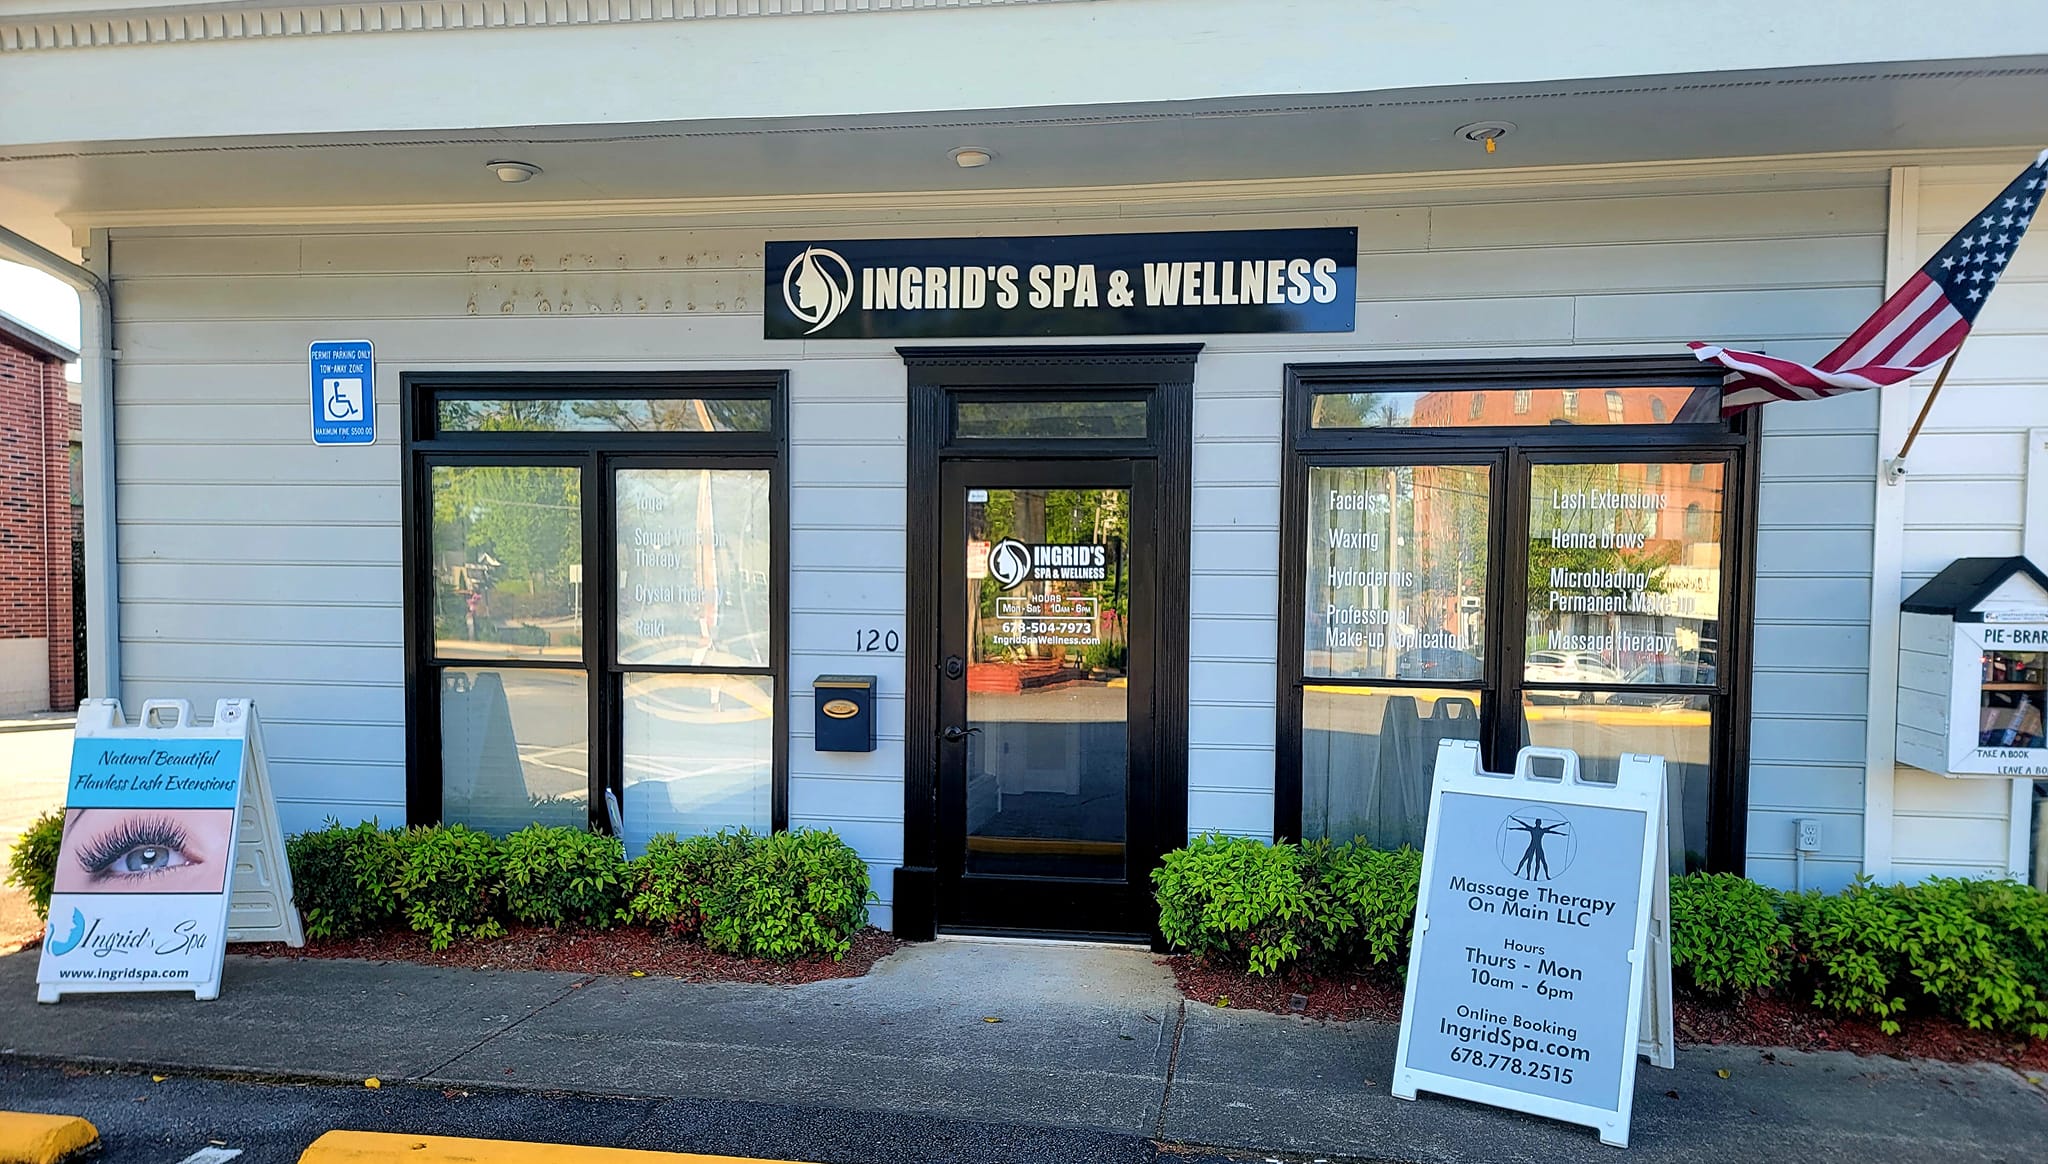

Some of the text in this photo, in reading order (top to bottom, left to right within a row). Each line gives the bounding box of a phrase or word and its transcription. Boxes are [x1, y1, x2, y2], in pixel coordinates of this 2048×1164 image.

[862, 258, 1337, 310] INGRID'S SPA & WELLNESS
[311, 351, 371, 360] PERMIT PARKING ONLY
[349, 364, 364, 373] ZONE
[315, 427, 373, 435] MAXIMUM FINE $500.00
[1330, 490, 1376, 510] Facials
[1553, 489, 1667, 509] Lash Extensions
[635, 528, 670, 546] Sound
[1329, 528, 1379, 551] Waxing
[1552, 528, 1645, 549] Henna brows
[635, 549, 681, 568] Therapy
[1034, 546, 1105, 566] INGRID'S
[1034, 567, 1105, 579] SPA & WELLNESS
[1551, 567, 1653, 591] Microblading/
[635, 584, 674, 605] Crystal
[1031, 595, 1062, 603] HOURS
[1550, 591, 1695, 615] Permanent Make-up
[635, 619, 664, 637] Reiki
[1002, 623, 1091, 633] 678-504-7973
[857, 629, 899, 652] 120
[993, 636, 1100, 645] IngridSpaWellness.com
[1326, 627, 1384, 650] Make-up
[1549, 630, 1673, 655] Massage therapy
[99, 750, 221, 769] Natural Beautiful
[1977, 750, 2029, 758] TAKE A BOOK
[1997, 766, 2023, 775] LEAVE
[2025, 767, 2032, 775] A
[74, 774, 236, 791] Flawless Lash Extensions
[1449, 876, 1616, 915] Massage Therapy
[1469, 897, 1591, 927] On Main LLC
[81, 918, 208, 957] Ingrid's Spa
[1504, 938, 1545, 955] Hours
[1465, 947, 1516, 970] Thurs
[1537, 959, 1582, 981] Mon
[59, 968, 189, 981] www.ingridspa.com
[1471, 968, 1514, 990] 10am
[1536, 980, 1574, 1000] 6pm
[1457, 1005, 1577, 1041] Online Booking
[1440, 1017, 1591, 1062] IngridSpa.com
[1450, 1046, 1574, 1084] 678.778.2515
